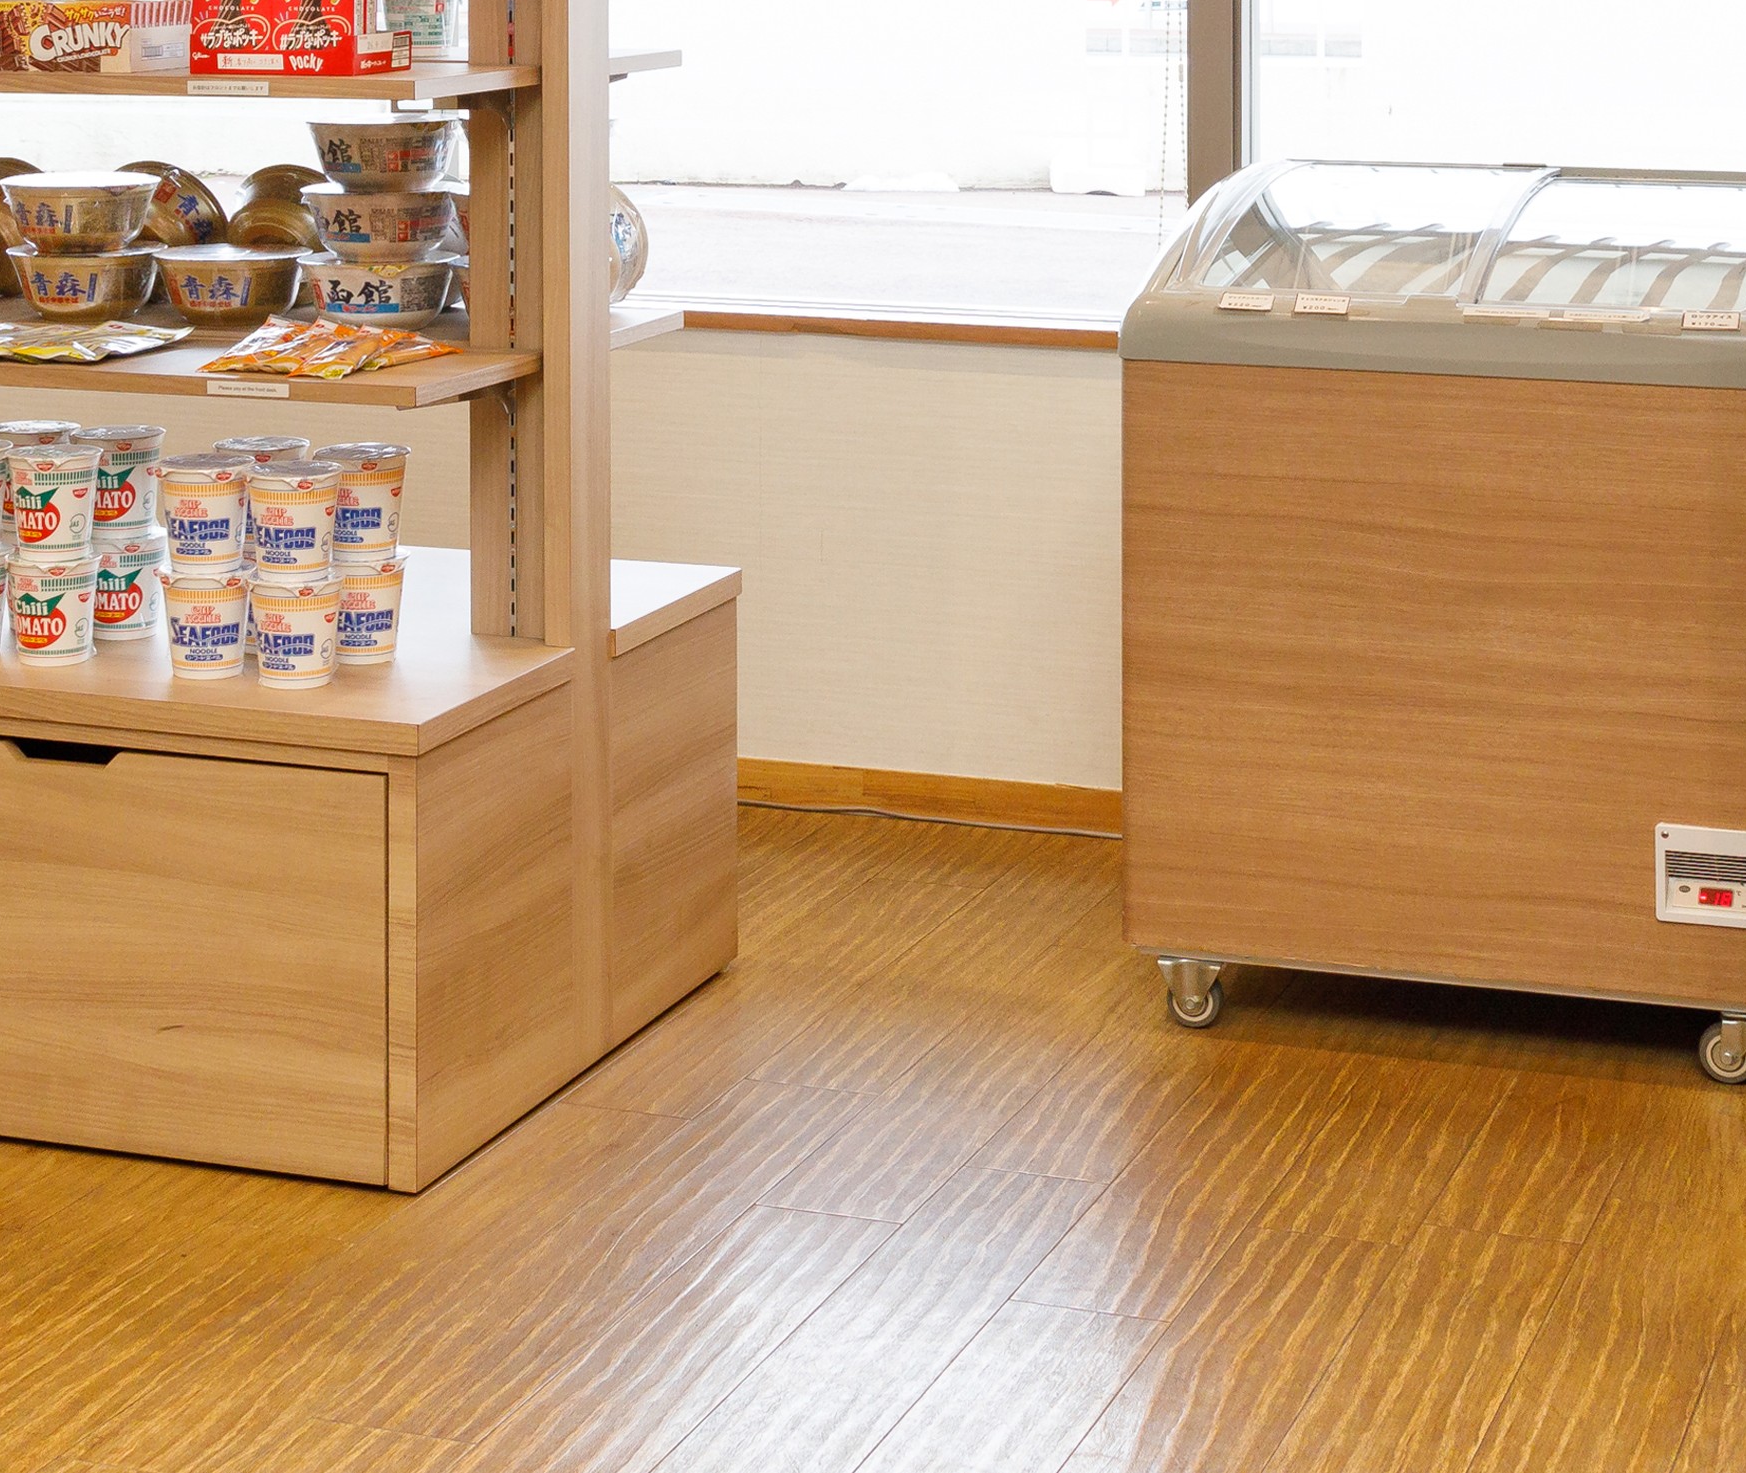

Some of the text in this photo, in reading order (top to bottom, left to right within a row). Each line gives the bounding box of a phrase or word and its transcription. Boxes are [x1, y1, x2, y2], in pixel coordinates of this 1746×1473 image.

[29, 23, 130, 60] CRUNKY
[31, 272, 87, 298] 青森
[180, 275, 239, 300] 青森
[326, 279, 394, 306] 函館
